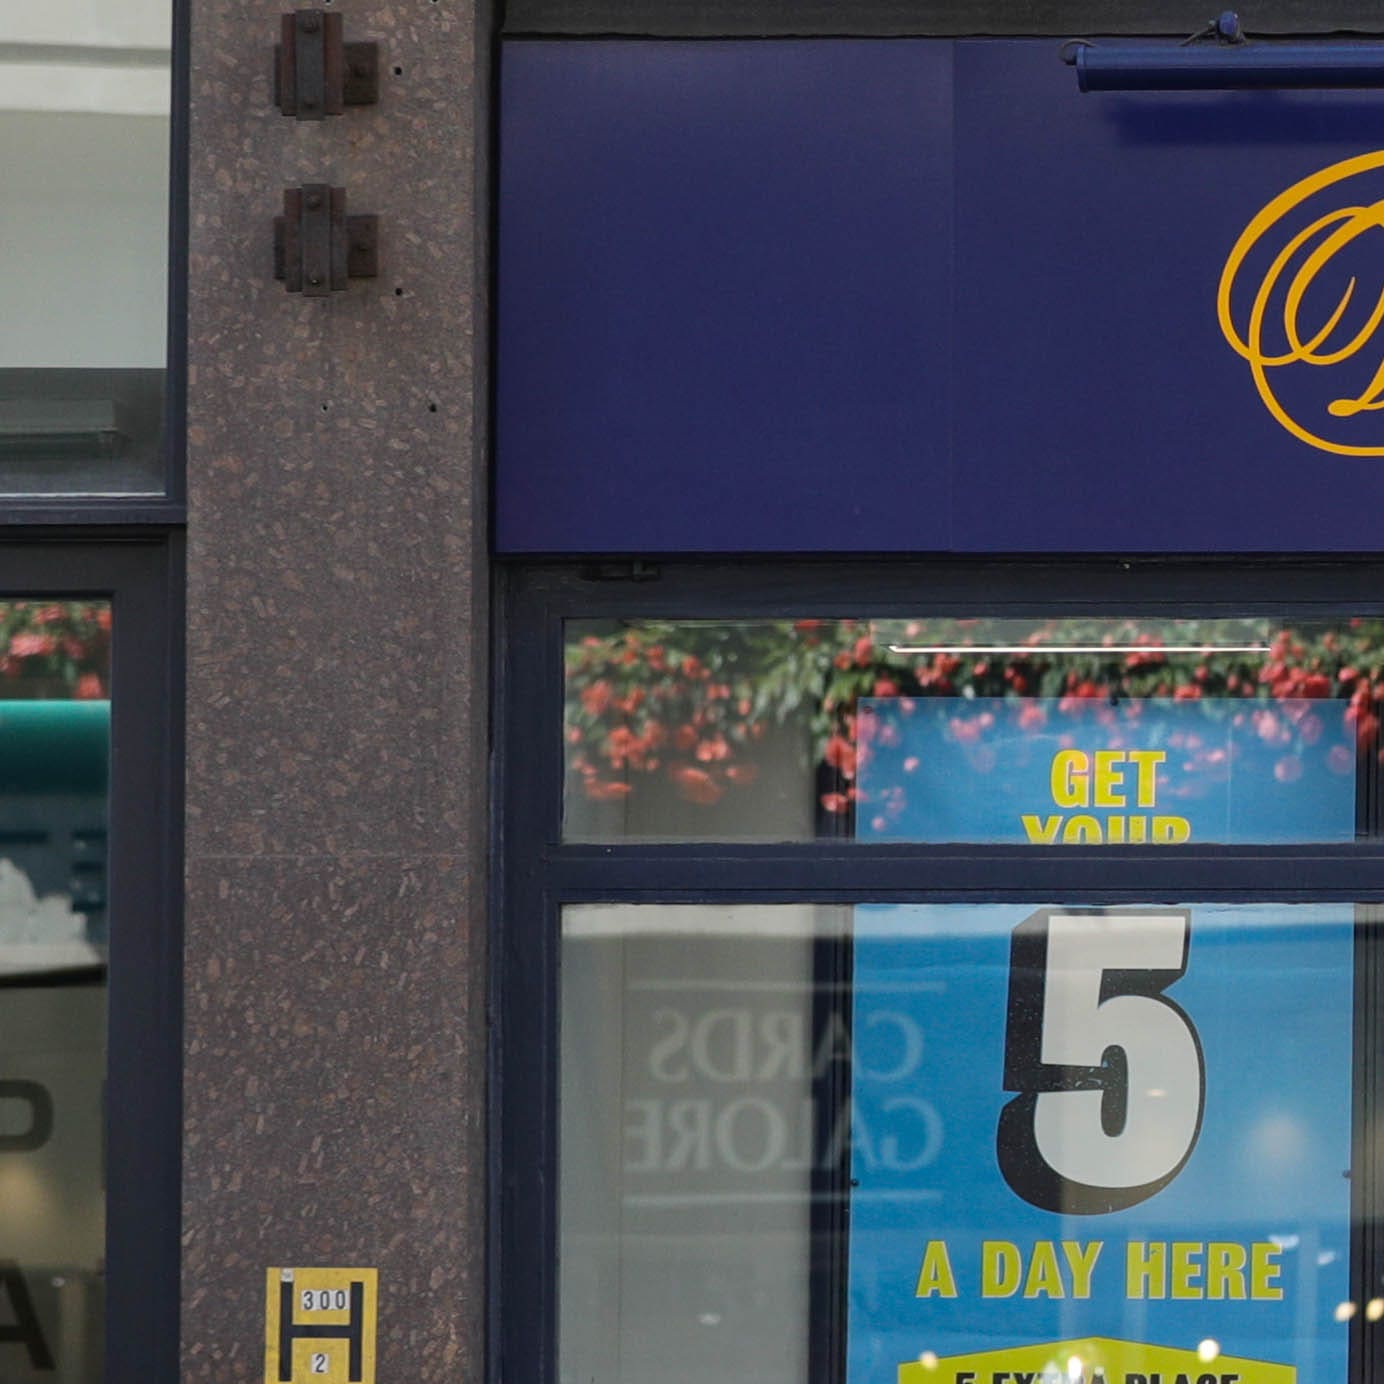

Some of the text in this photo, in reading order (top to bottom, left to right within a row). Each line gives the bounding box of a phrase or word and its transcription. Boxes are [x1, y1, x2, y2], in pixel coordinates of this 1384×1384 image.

[1050, 749, 1166, 808] GET
[996, 908, 1206, 1216] 5
[915, 1241, 1284, 1300] A DAY HERE
[303, 1291, 346, 1310] 300
[278, 1281, 363, 1382] H
[315, 1354, 325, 1373] 2
